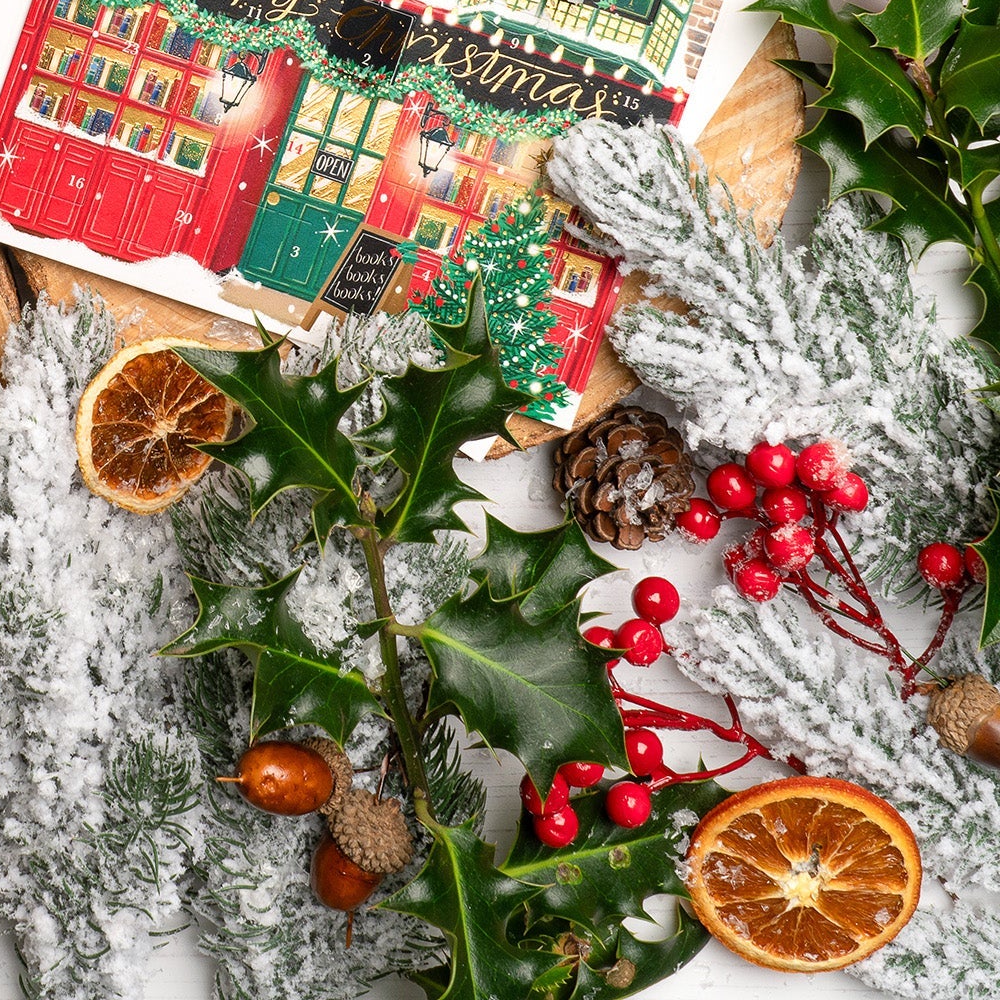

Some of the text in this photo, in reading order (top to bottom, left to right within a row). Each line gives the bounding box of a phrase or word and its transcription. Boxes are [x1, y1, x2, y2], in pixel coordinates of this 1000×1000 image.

[122, 40, 139, 55] 23
[510, 37, 520, 49] 9
[334, 4, 617, 119] Christmas
[362, 52, 372, 66] 2
[622, 95, 640, 110] 15
[287, 140, 303, 155] 14
[316, 154, 350, 178] OPEN
[68, 174, 86, 190] 16
[407, 173, 417, 184] 7
[175, 210, 193, 225] 20
[290, 246, 301, 258] 3
[355, 244, 396, 267] books
[345, 263, 386, 285] books
[421, 269, 431, 282] 4
[333, 280, 381, 302] books!
[530, 361, 546, 376] 12
